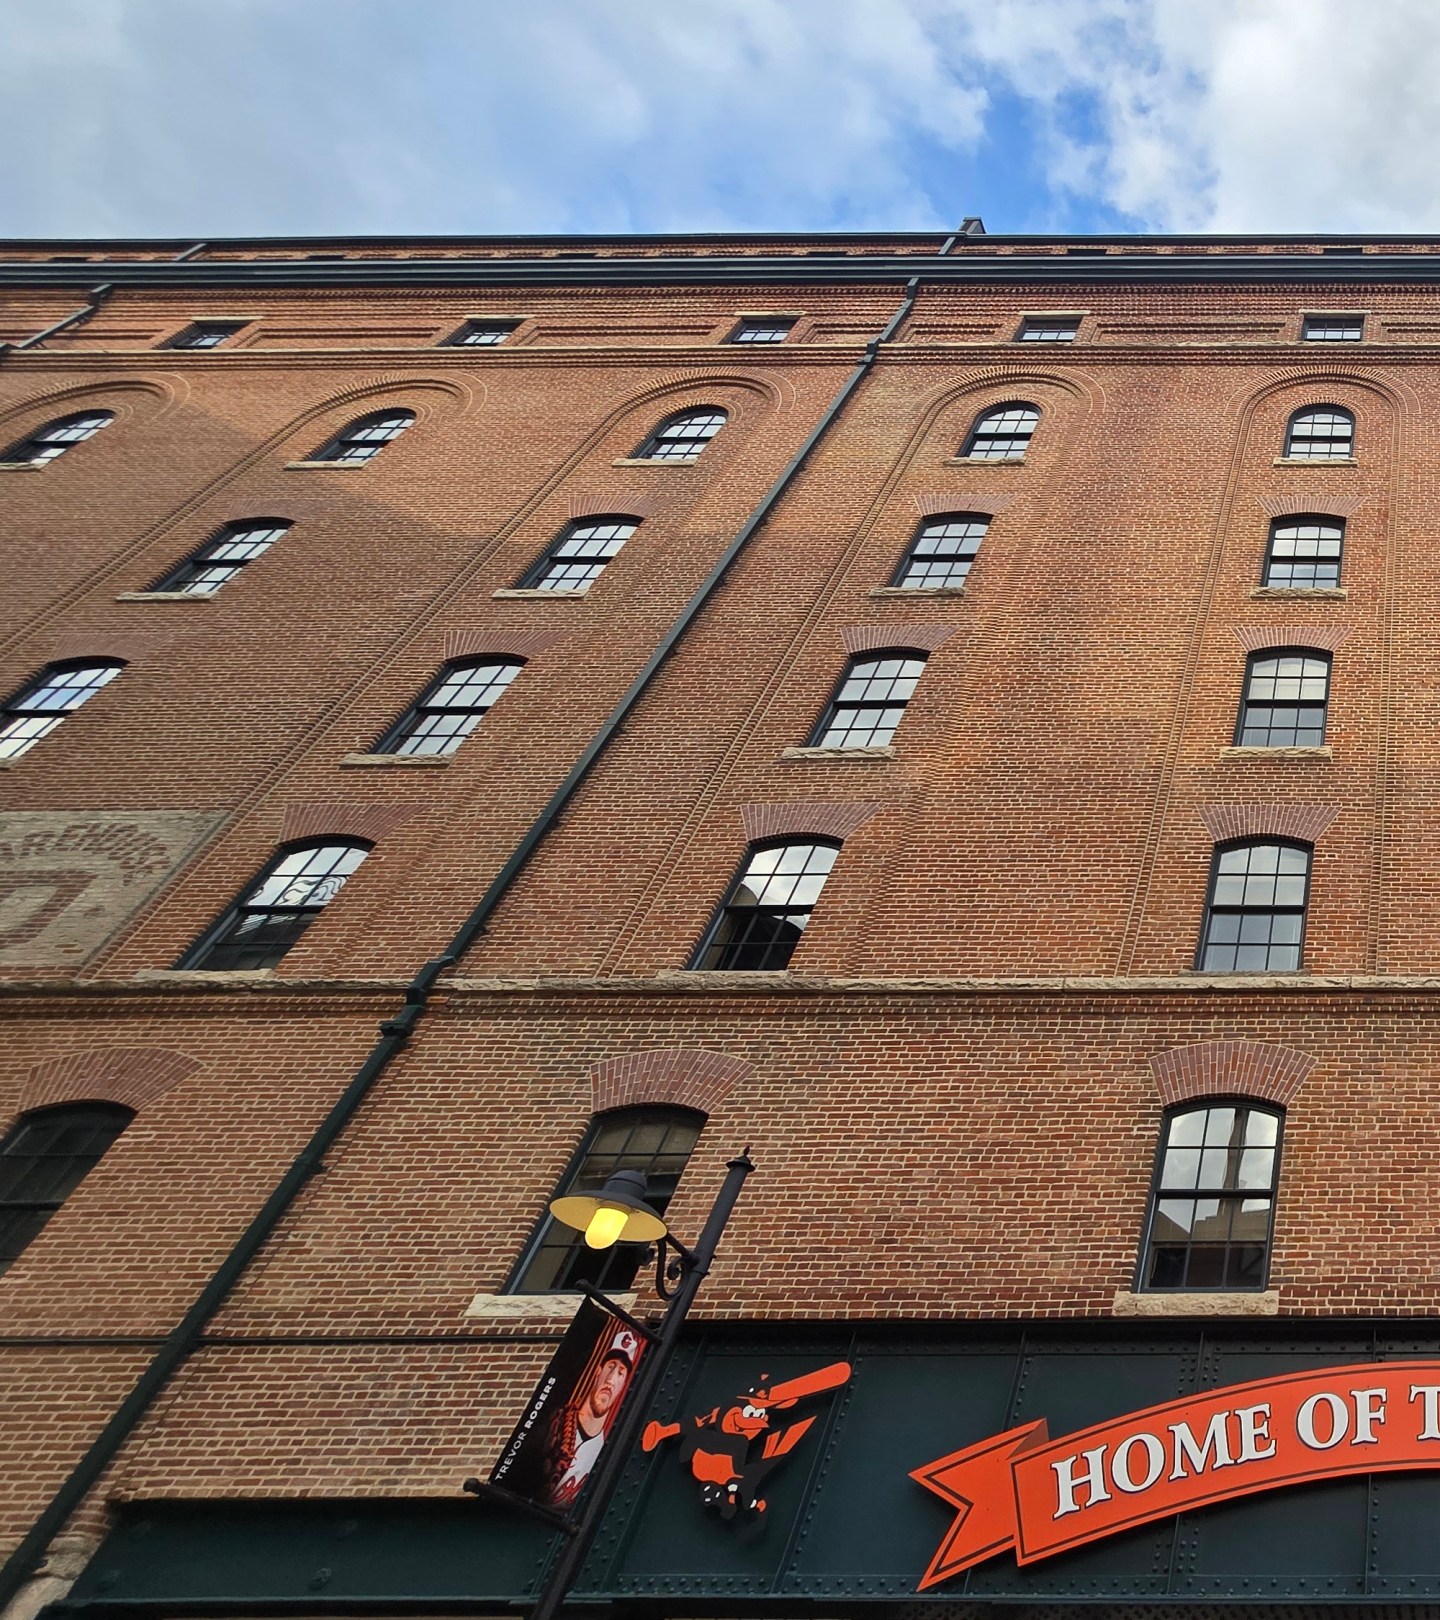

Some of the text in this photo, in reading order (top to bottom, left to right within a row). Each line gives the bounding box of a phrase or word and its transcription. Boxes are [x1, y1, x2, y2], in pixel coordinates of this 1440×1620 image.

[495, 1376, 557, 1481] TREVOR ROGERS
[1051, 1403, 1277, 1520] HOME
[1296, 1387, 1388, 1450] OF
